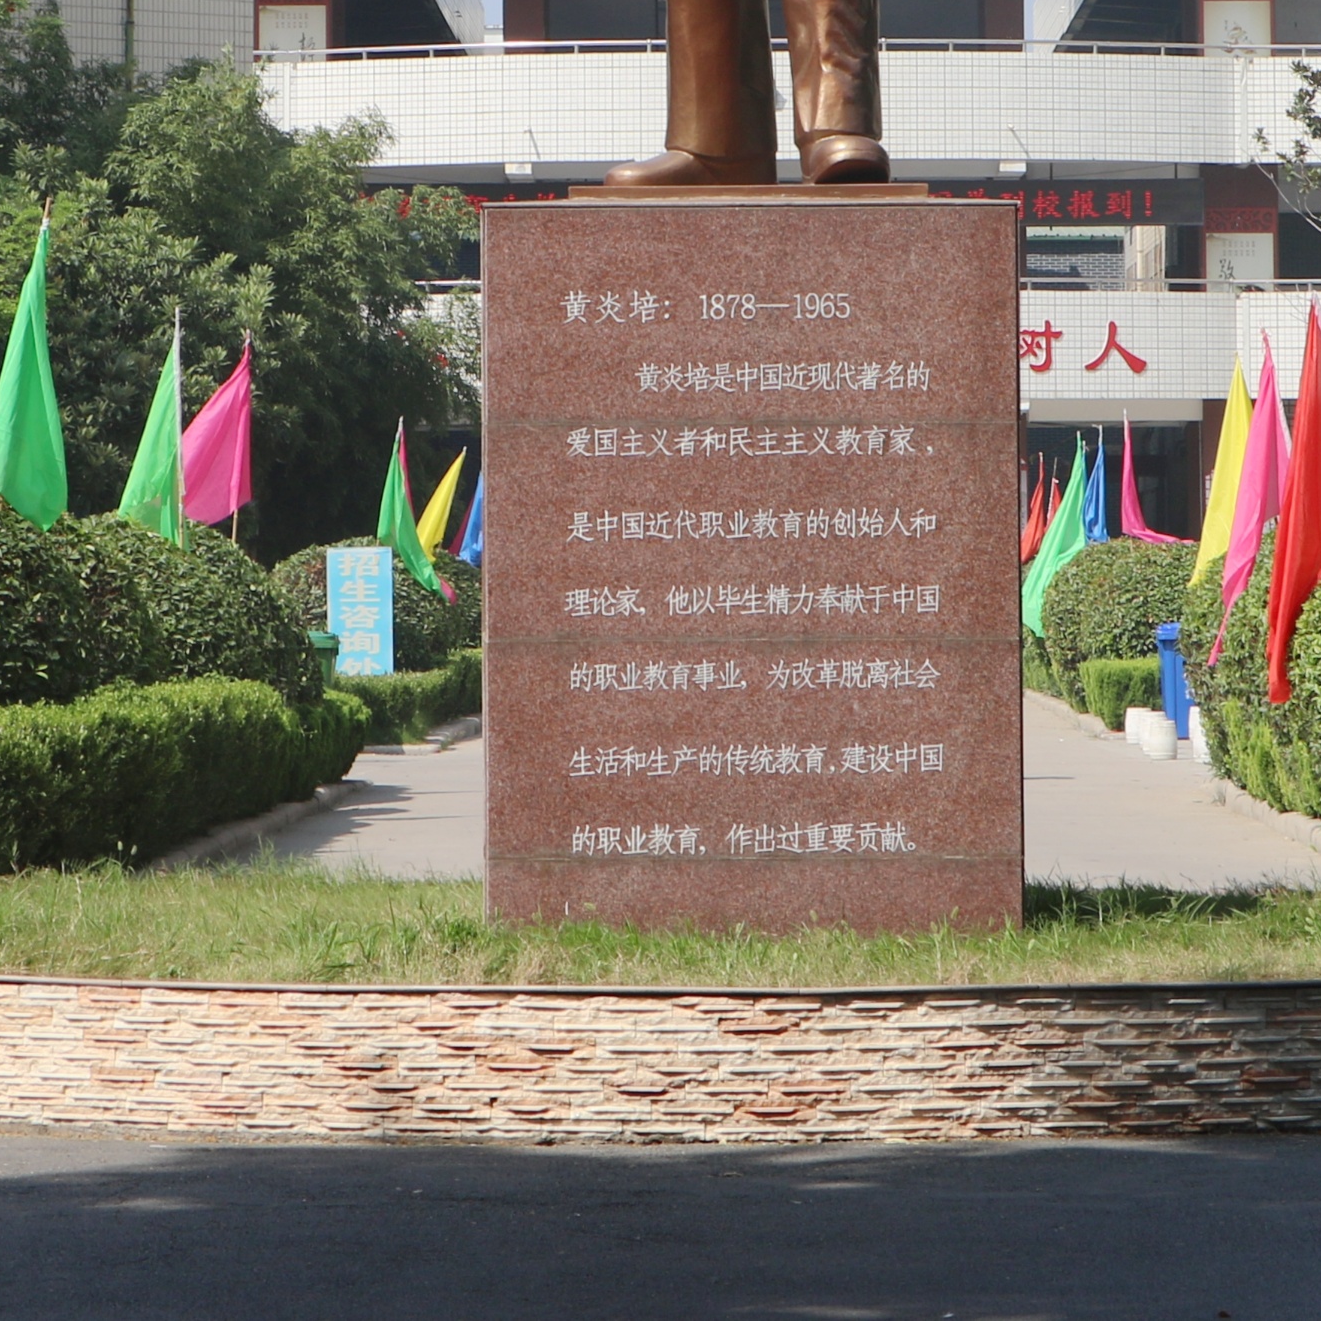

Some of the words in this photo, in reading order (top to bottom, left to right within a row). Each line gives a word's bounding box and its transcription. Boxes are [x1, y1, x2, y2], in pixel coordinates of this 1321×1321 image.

[635, 360, 930, 395] 黄炎培是中国近现代著名的
[566, 426, 934, 458] 爱国主义者和民主主义教育家，
[567, 508, 937, 543] 是中国近代职业教育的创始人和
